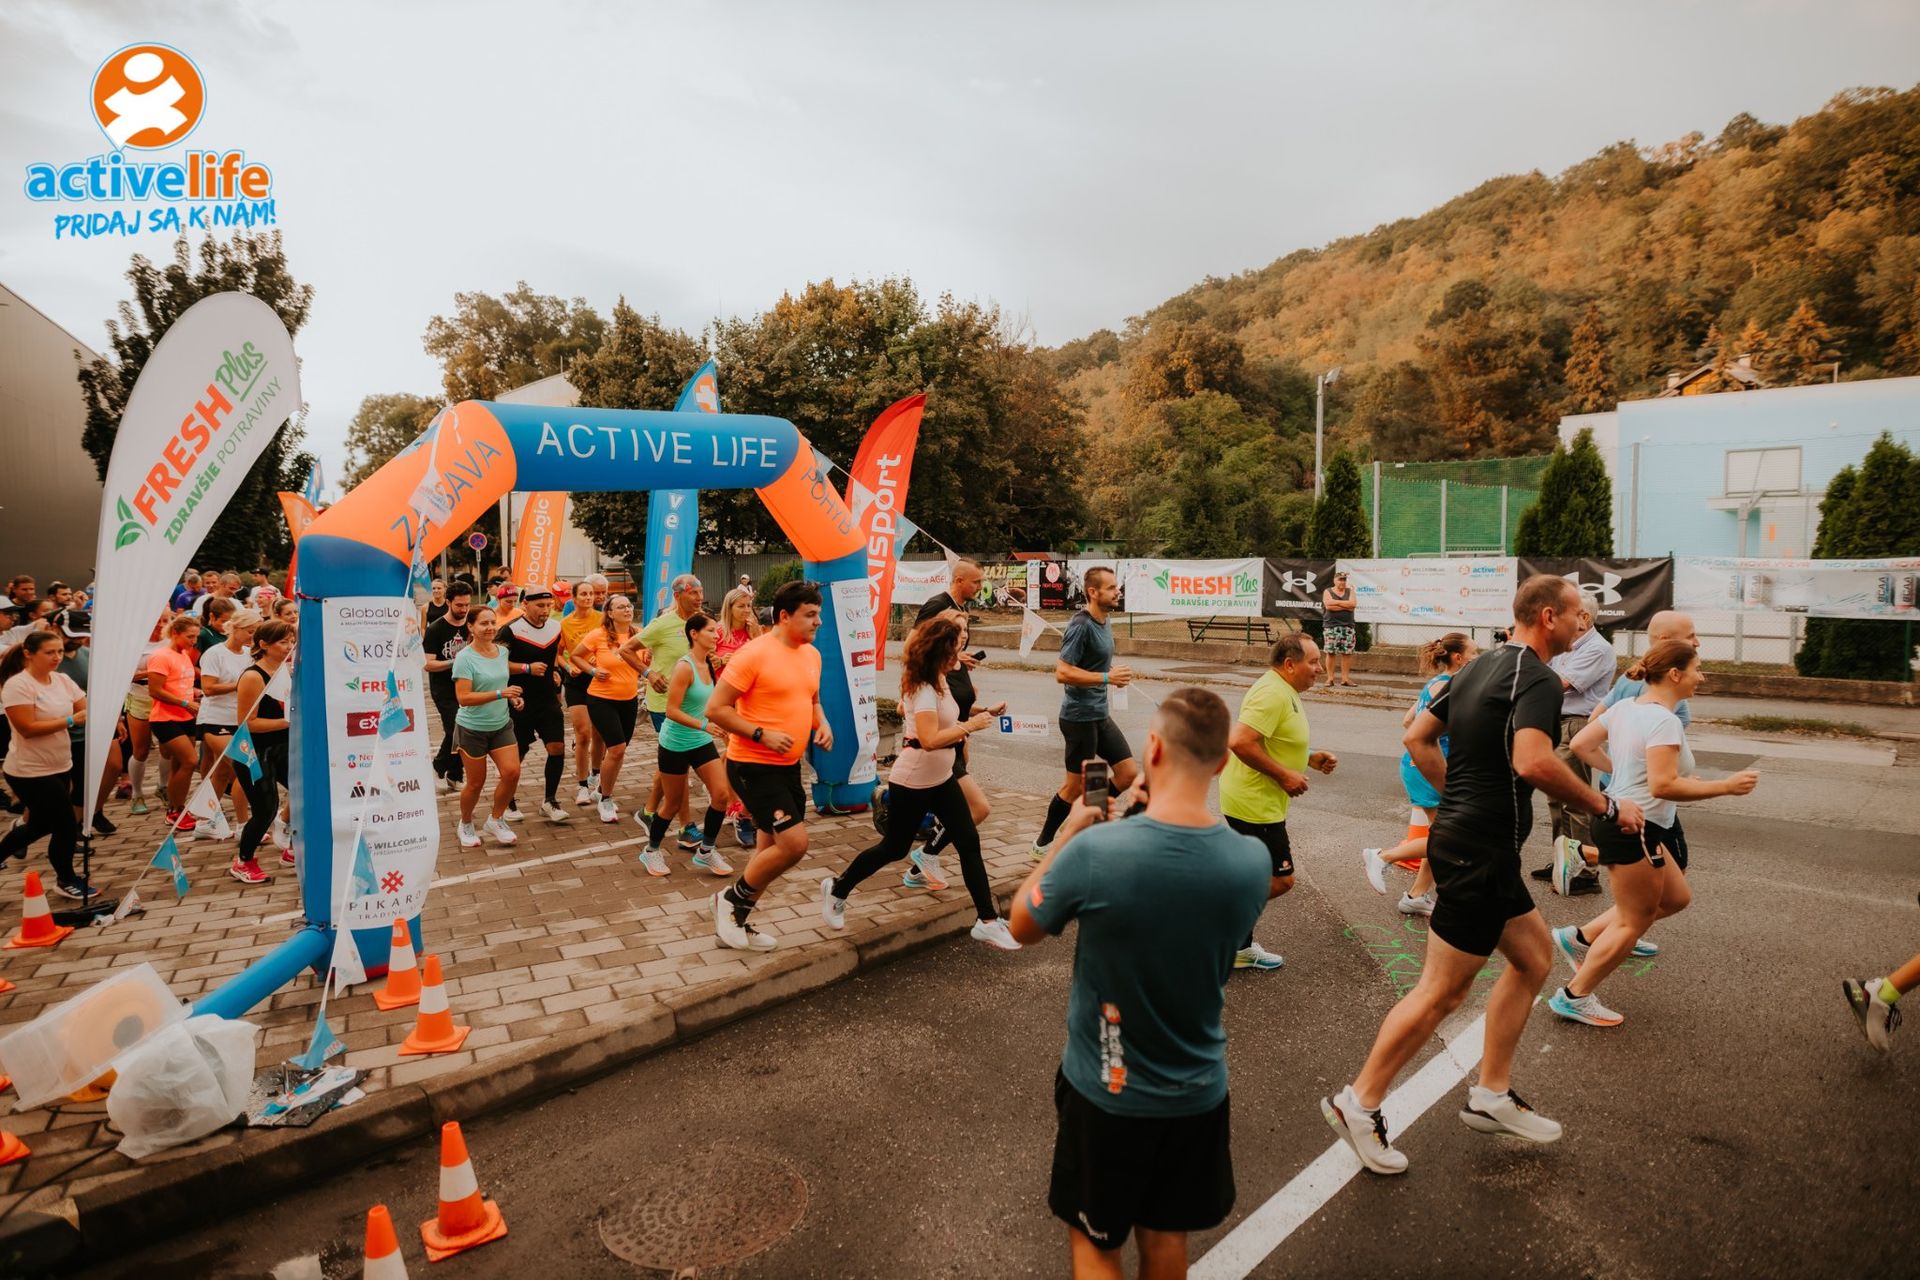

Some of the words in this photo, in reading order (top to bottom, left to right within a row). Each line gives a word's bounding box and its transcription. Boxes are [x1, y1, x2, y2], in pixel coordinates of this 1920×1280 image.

[536, 421, 693, 465] ACTIVE
[711, 435, 778, 468] LIFE
[132, 384, 234, 526] FRESH
[163, 462, 221, 545] ZDRAVŠIE
[217, 376, 283, 465] POTRAVINY
[525, 498, 551, 589] lobalLogic
[1170, 576, 1232, 595] FRESH
[1171, 596, 1209, 606] ZDRAVŠIE
[1212, 599, 1257, 607] POTRAVINY
[339, 607, 400, 618] GlobalLo
[361, 680, 406, 693] FREH
[397, 809, 425, 820] Braven
